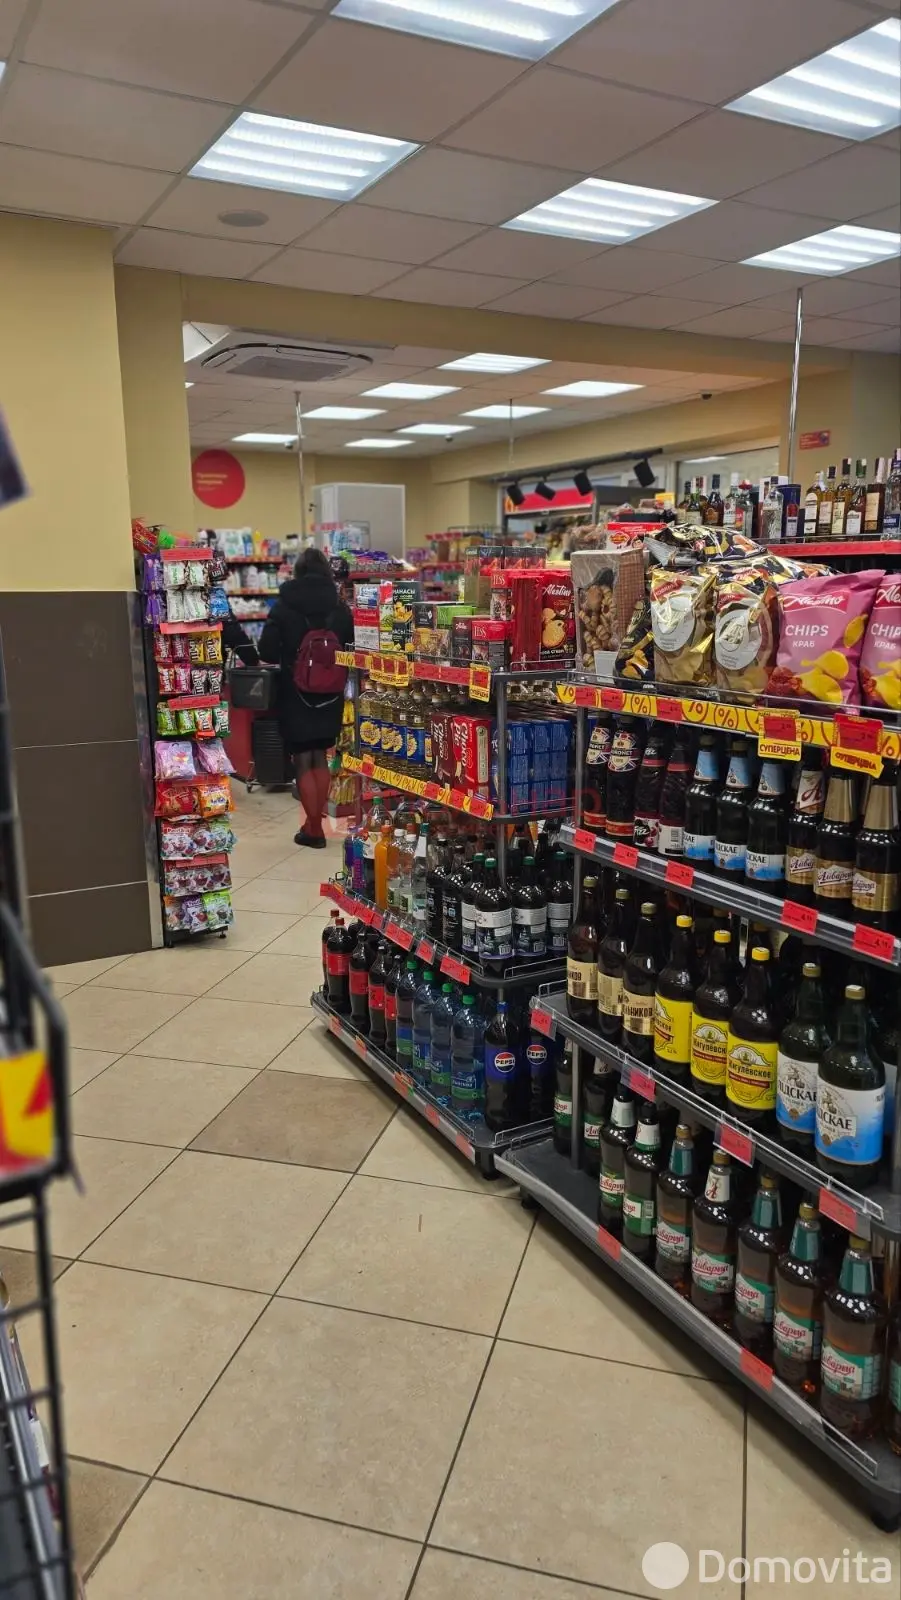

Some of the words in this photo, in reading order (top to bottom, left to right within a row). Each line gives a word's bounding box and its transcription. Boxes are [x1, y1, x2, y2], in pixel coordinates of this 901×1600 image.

[784, 624, 830, 637] CHIPS
[792, 640, 815, 649] КРАБ
[873, 640, 897, 651] КРАБ
[461, 722, 469, 767] Choco
[759, 743, 801, 757] СУПЕРЦЕНА
[527, 1051, 547, 1059] PEPSI
